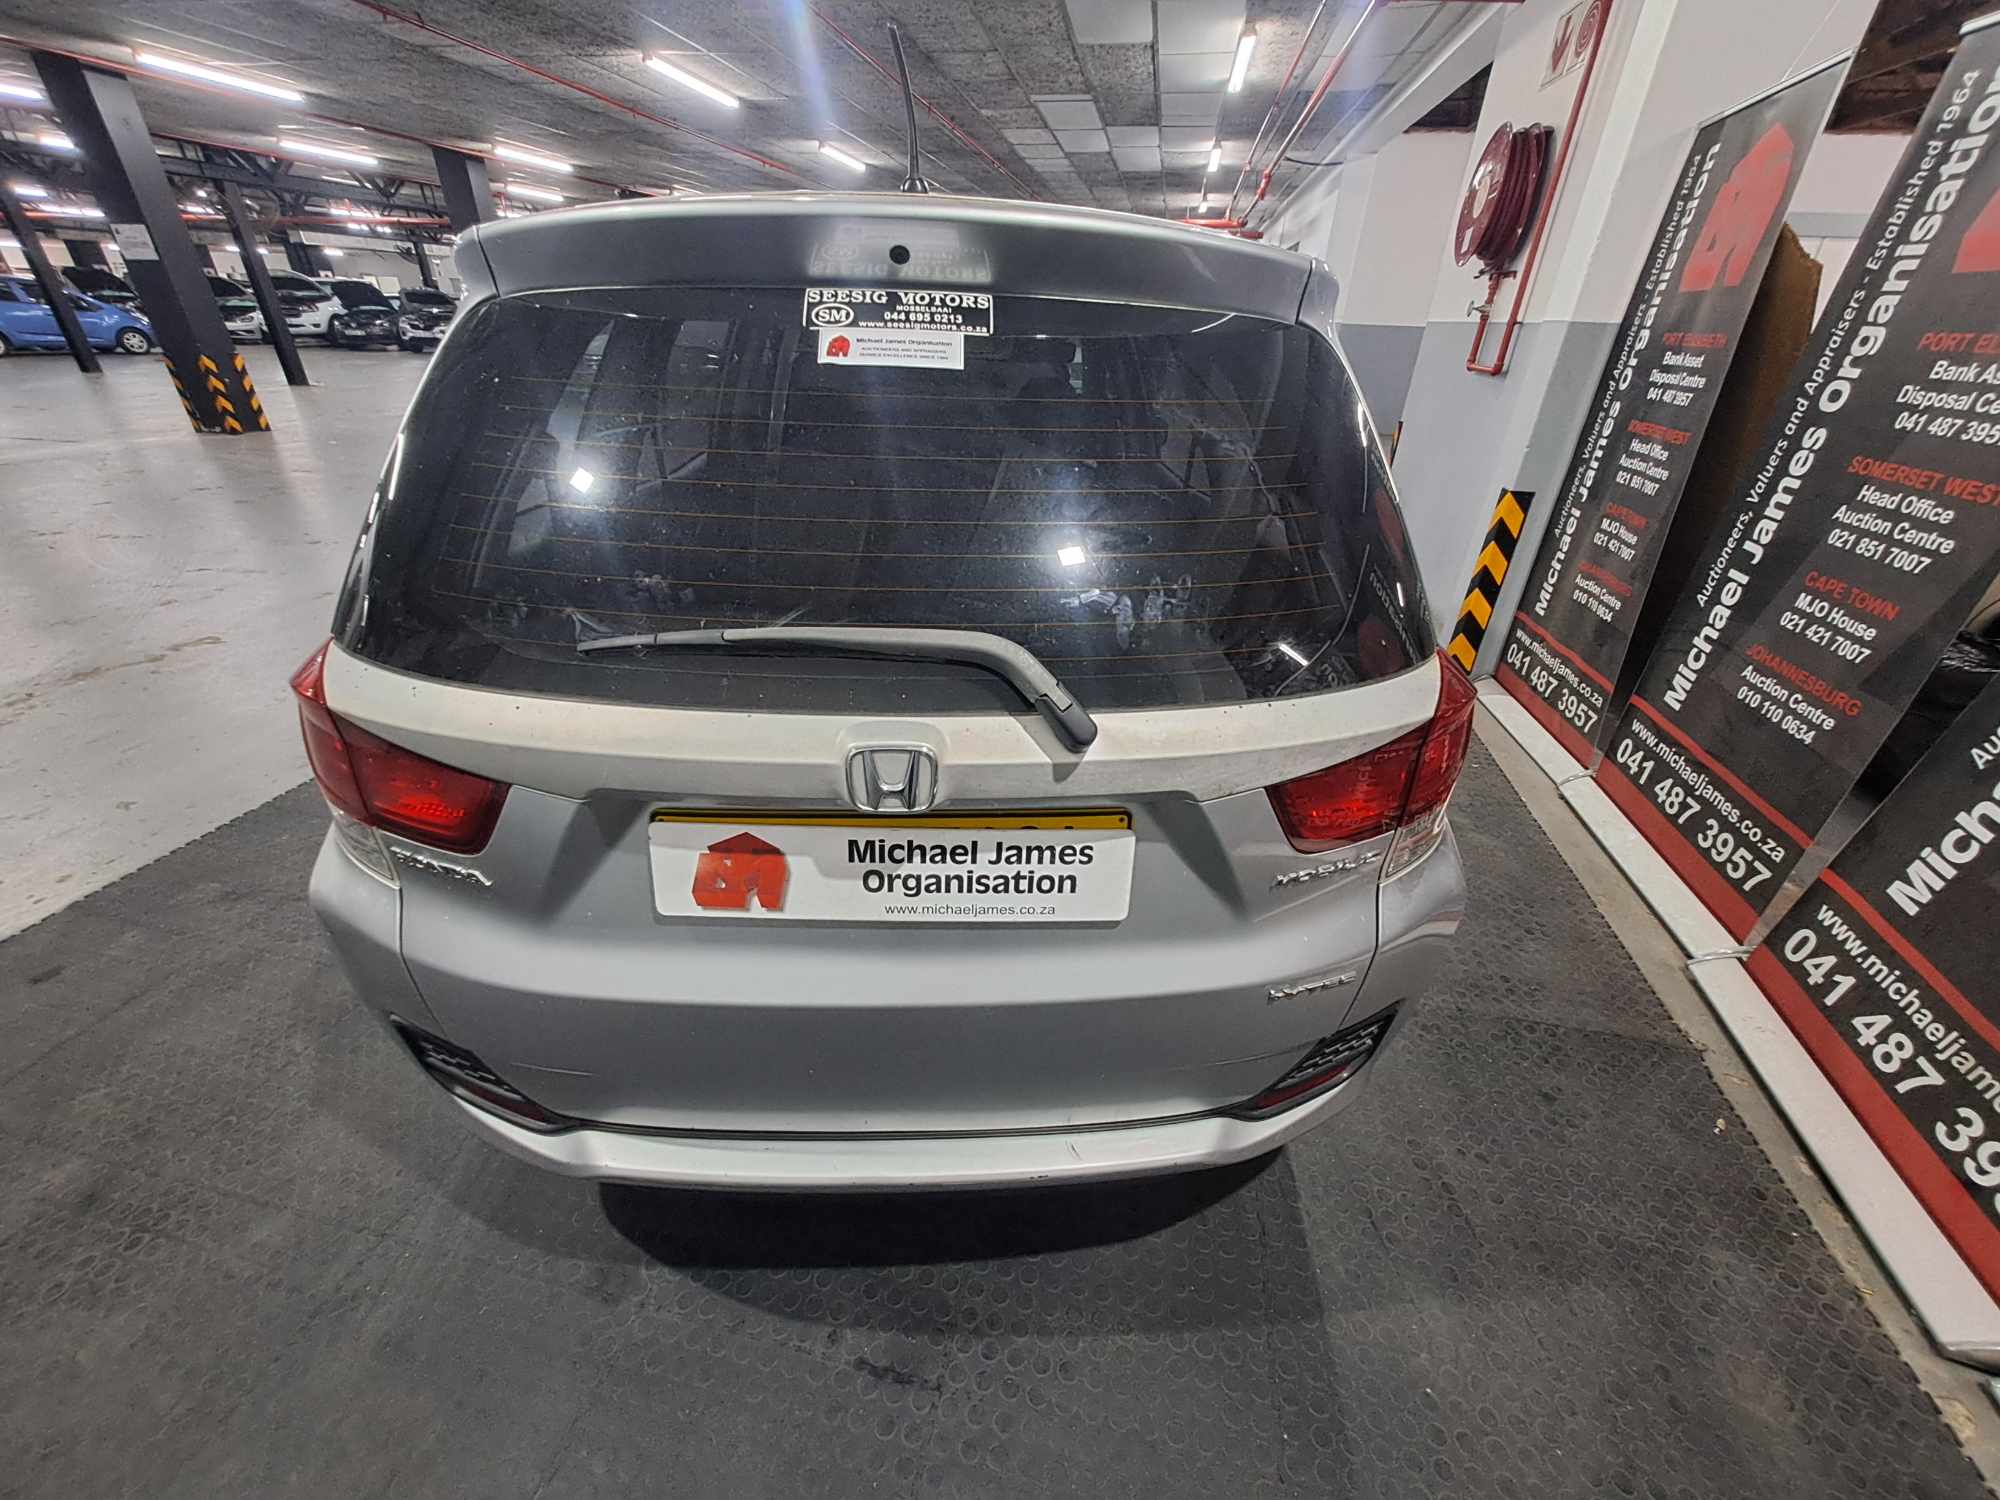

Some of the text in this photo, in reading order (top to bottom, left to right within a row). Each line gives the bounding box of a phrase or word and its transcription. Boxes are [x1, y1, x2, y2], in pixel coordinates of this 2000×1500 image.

[808, 290, 989, 309] SEESIG MOTORS
[817, 309, 848, 322] SM
[884, 312, 963, 324] 044 695 0213
[858, 320, 988, 334] www.seesigmotors.co.za
[1696, 510, 1754, 608] Auctioneers,
[1745, 438, 1788, 504] Valuers
[1784, 396, 1810, 436] and
[1803, 289, 1867, 396] Appraisers
[1865, 139, 1945, 271] Established
[1936, 68, 1982, 133] 1964
[1917, 332, 1977, 352] PORT
[1534, 506, 1582, 617] Michael
[1578, 400, 1621, 503] James
[1618, 142, 1722, 391] Organisation
[1928, 359, 1981, 383] Bank
[1602, 380, 1616, 408] and
[1895, 384, 1980, 411] Disposal
[1629, 438, 1652, 455] Head
[1894, 411, 2000, 446] 041 487 395
[1846, 455, 1945, 491] SOMERSET
[1857, 483, 1955, 525] Head Office
[1600, 518, 1620, 535] MJO
[1831, 503, 1956, 554] Auction Centre
[1663, 567, 1751, 712] Michael
[1742, 426, 1828, 566] James
[1826, 528, 1934, 575] 021 851 7007
[1575, 573, 1602, 596] Auction
[1804, 570, 1900, 621] CAPE TOWN
[1779, 611, 1872, 664] 021 421 7007
[1794, 592, 1878, 641] MJO House
[1507, 643, 1598, 733] 041 487 3957
[1515, 628, 1604, 709] www.michaeljames.co.za
[1745, 642, 1862, 717] JOHANNESBURG
[1736, 685, 1817, 745] 010 110 0634
[1740, 664, 1836, 731] Auction Centre
[1631, 718, 1785, 864] www.michaeljames.co.za
[1616, 738, 1773, 892] 041 487 3957
[847, 839, 1094, 866] Michael James
[1885, 781, 2000, 916] Mich
[862, 869, 1077, 898] Organisation
[885, 903, 1056, 917] www.michaeljames.co.za
[1784, 928, 2000, 1212] 041 487 39
